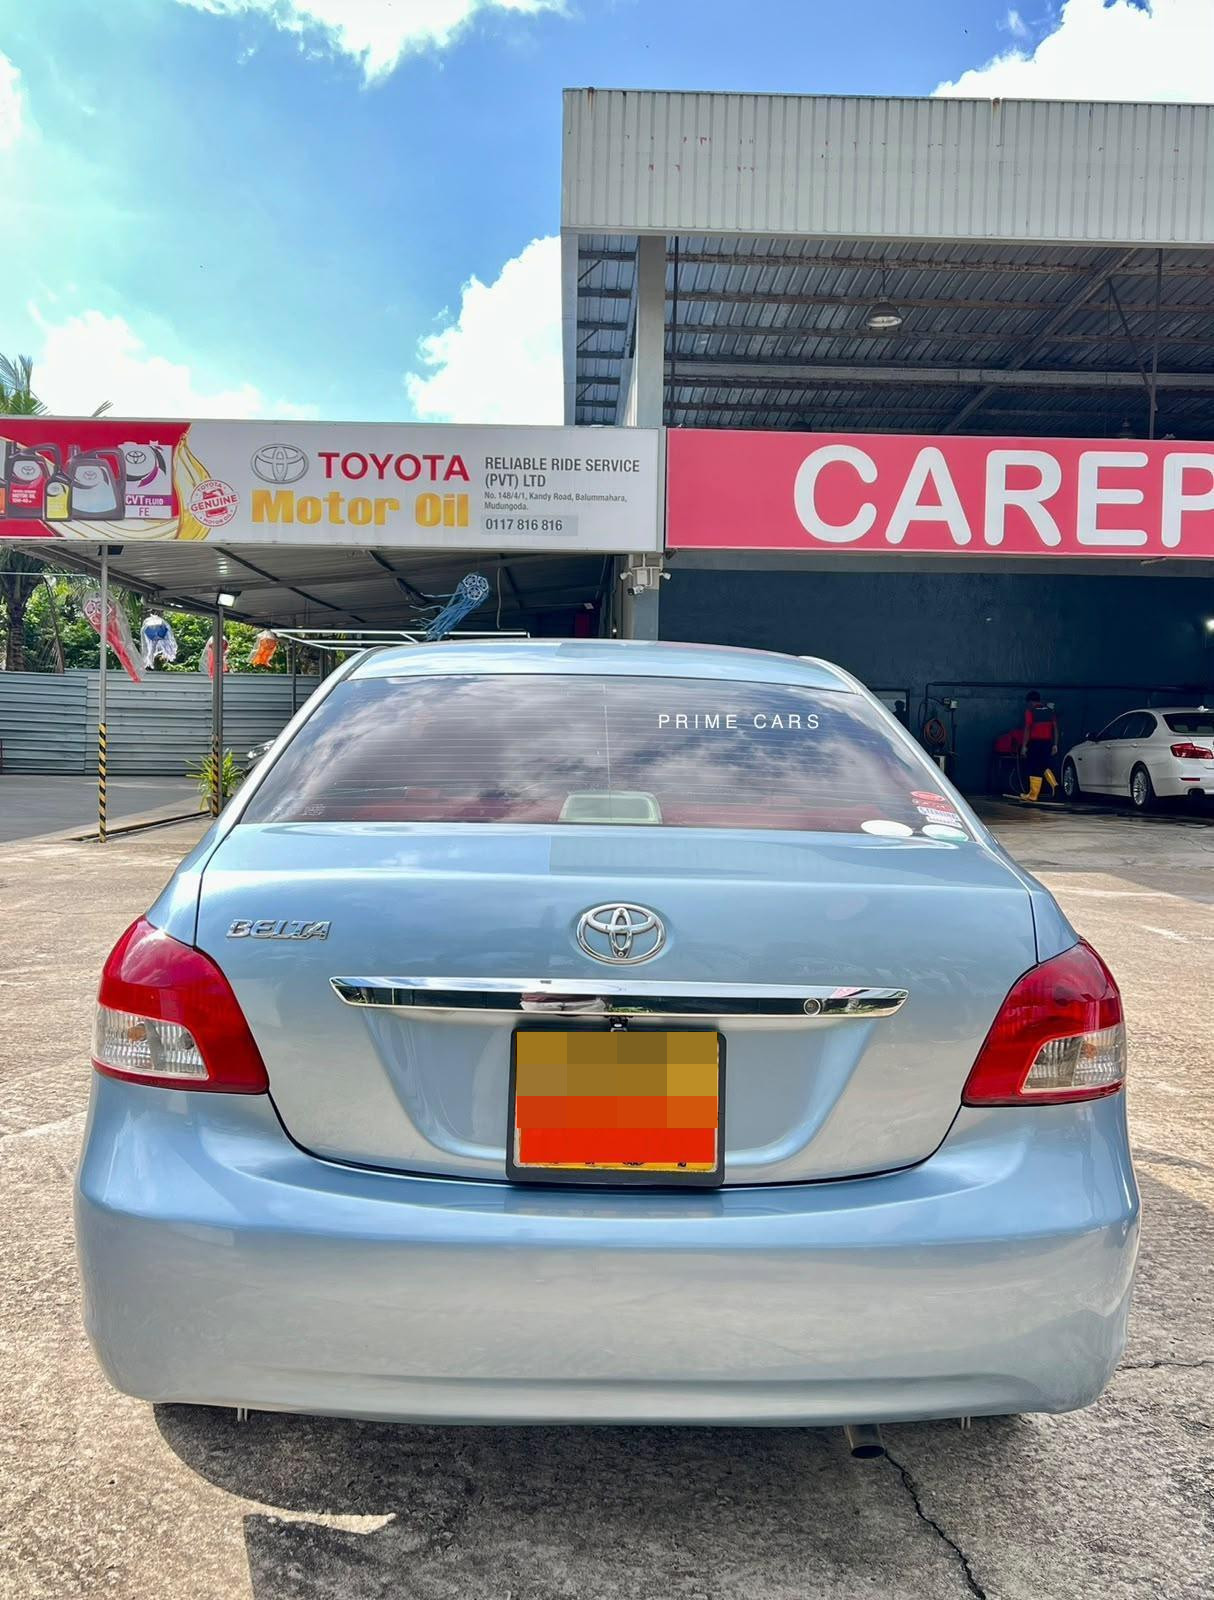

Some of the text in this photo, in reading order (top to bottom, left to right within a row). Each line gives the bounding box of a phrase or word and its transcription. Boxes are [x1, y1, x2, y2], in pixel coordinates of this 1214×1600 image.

[317, 452, 470, 482] TOYOTA
[485, 456, 640, 472] RELIABLE RIDE SERVICE
[485, 473, 546, 489] (PVT) LTD
[125, 495, 145, 505] CVT
[191, 494, 237, 512] GENUINE
[498, 492, 528, 500] 148/4/1,
[529, 492, 551, 502] Kandy
[552, 493, 574, 502] Road,
[793, 444, 1214, 548] CAREP
[138, 507, 149, 517] FE
[251, 489, 469, 528] Motor Oil
[484, 502, 529, 512] Mudungoda.
[485, 518, 563, 531] 0117 816 816
[658, 714, 821, 729] PRIME CARS
[226, 919, 332, 940] BELTA
